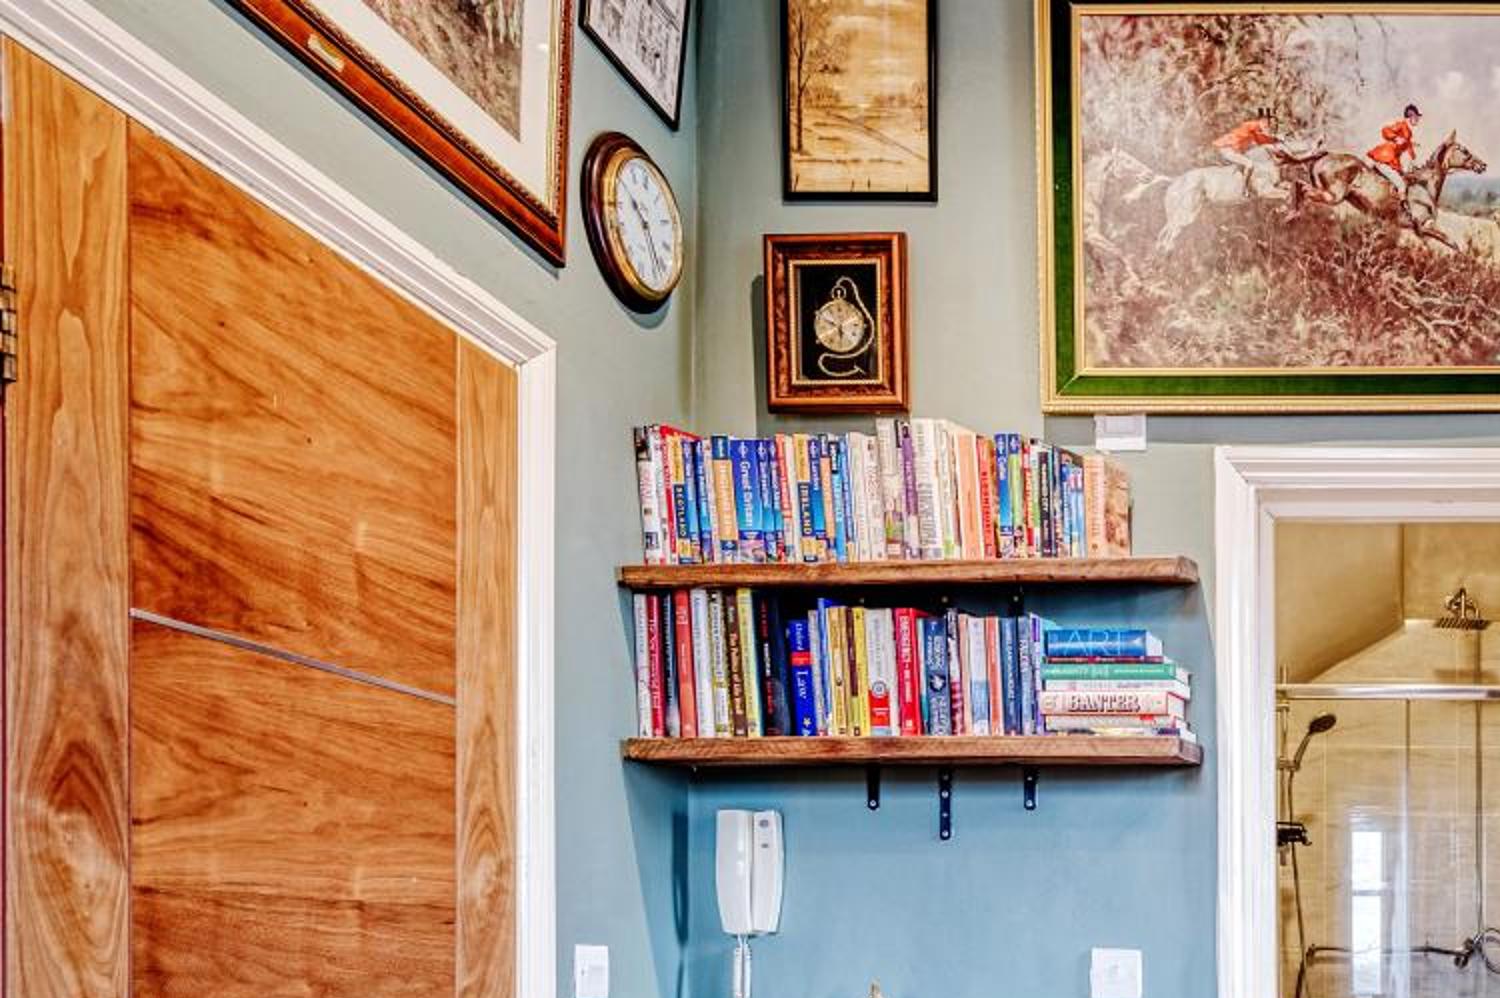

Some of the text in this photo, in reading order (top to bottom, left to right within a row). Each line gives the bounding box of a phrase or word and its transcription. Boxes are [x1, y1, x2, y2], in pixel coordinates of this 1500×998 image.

[676, 486, 687, 538] SCOTLAND
[739, 460, 754, 528] Great Britain
[801, 483, 813, 535] IRELAND
[1064, 630, 1121, 657] ART
[796, 670, 809, 700] Law
[1068, 695, 1141, 713] BANTER
